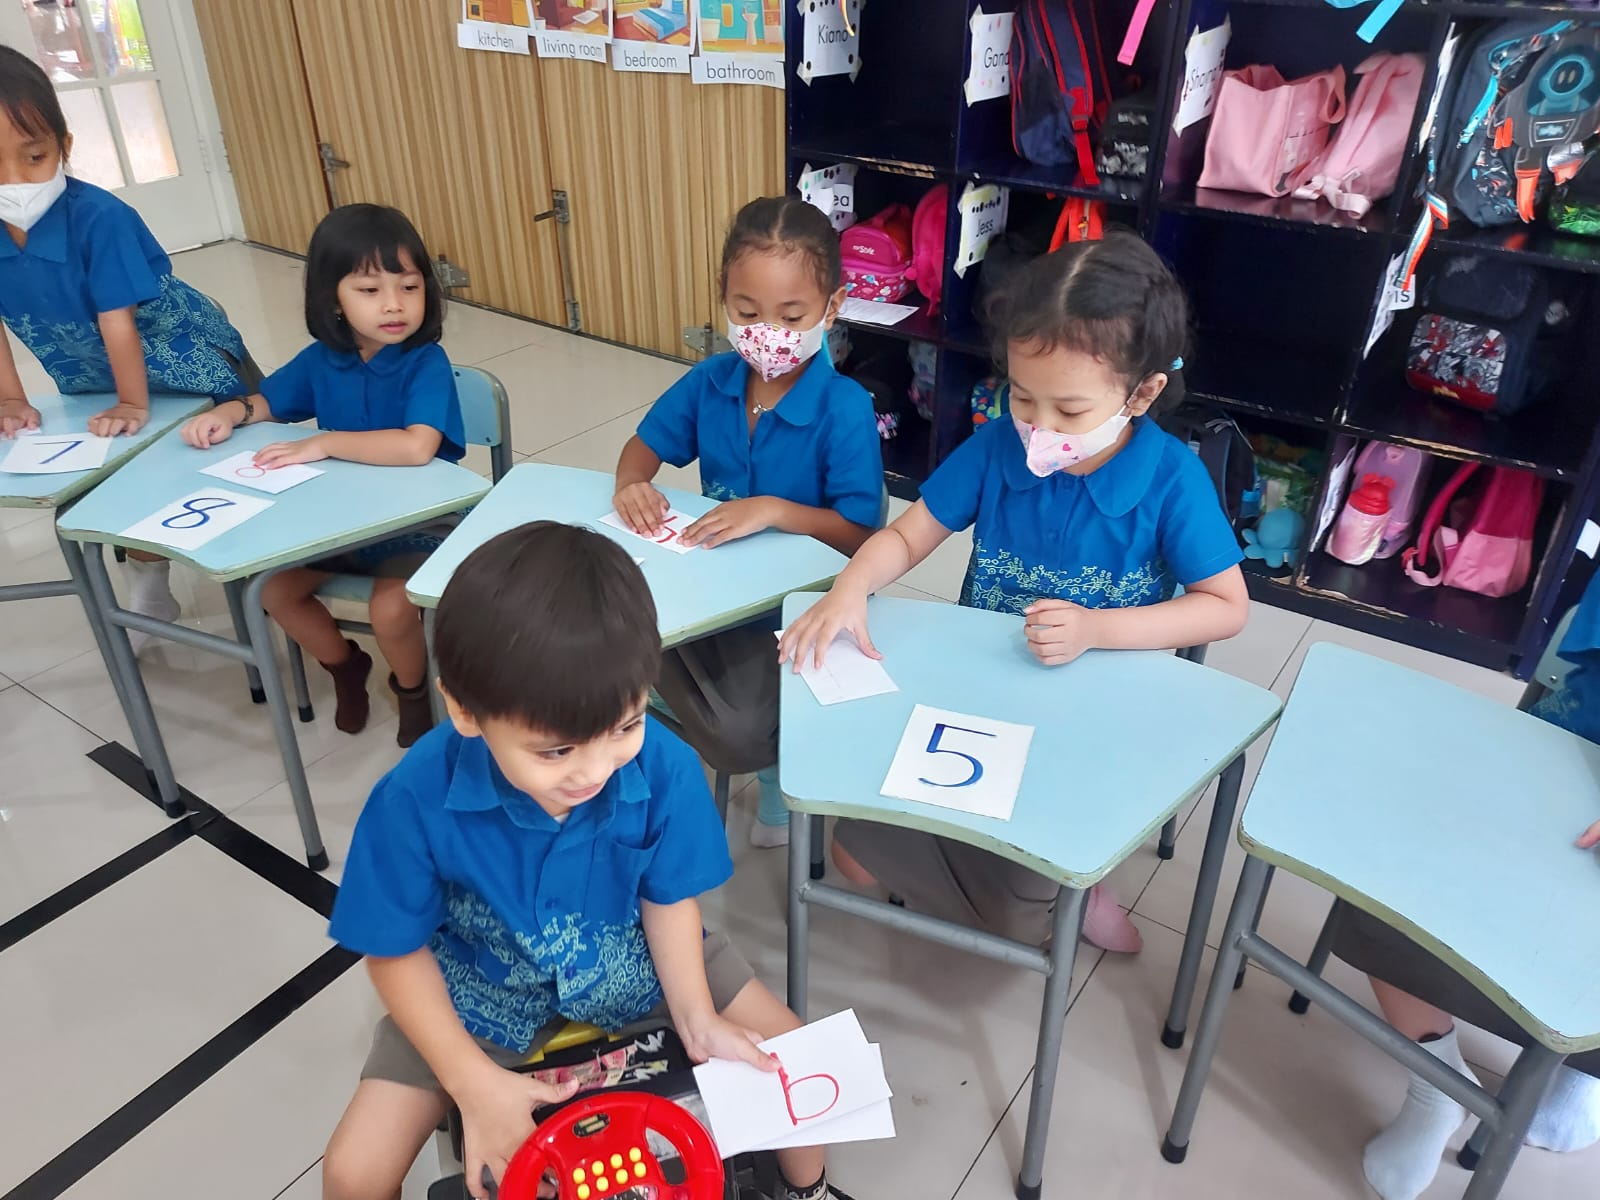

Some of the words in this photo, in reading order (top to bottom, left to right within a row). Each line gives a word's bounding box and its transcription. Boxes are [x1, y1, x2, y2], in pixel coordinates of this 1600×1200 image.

[477, 30, 514, 48] kitchen
[542, 36, 577, 57] living
[624, 50, 678, 68] bedroom
[706, 61, 776, 82] bathroom
[33, 440, 84, 465] 7
[161, 497, 236, 529] 8
[918, 723, 998, 788] 5
